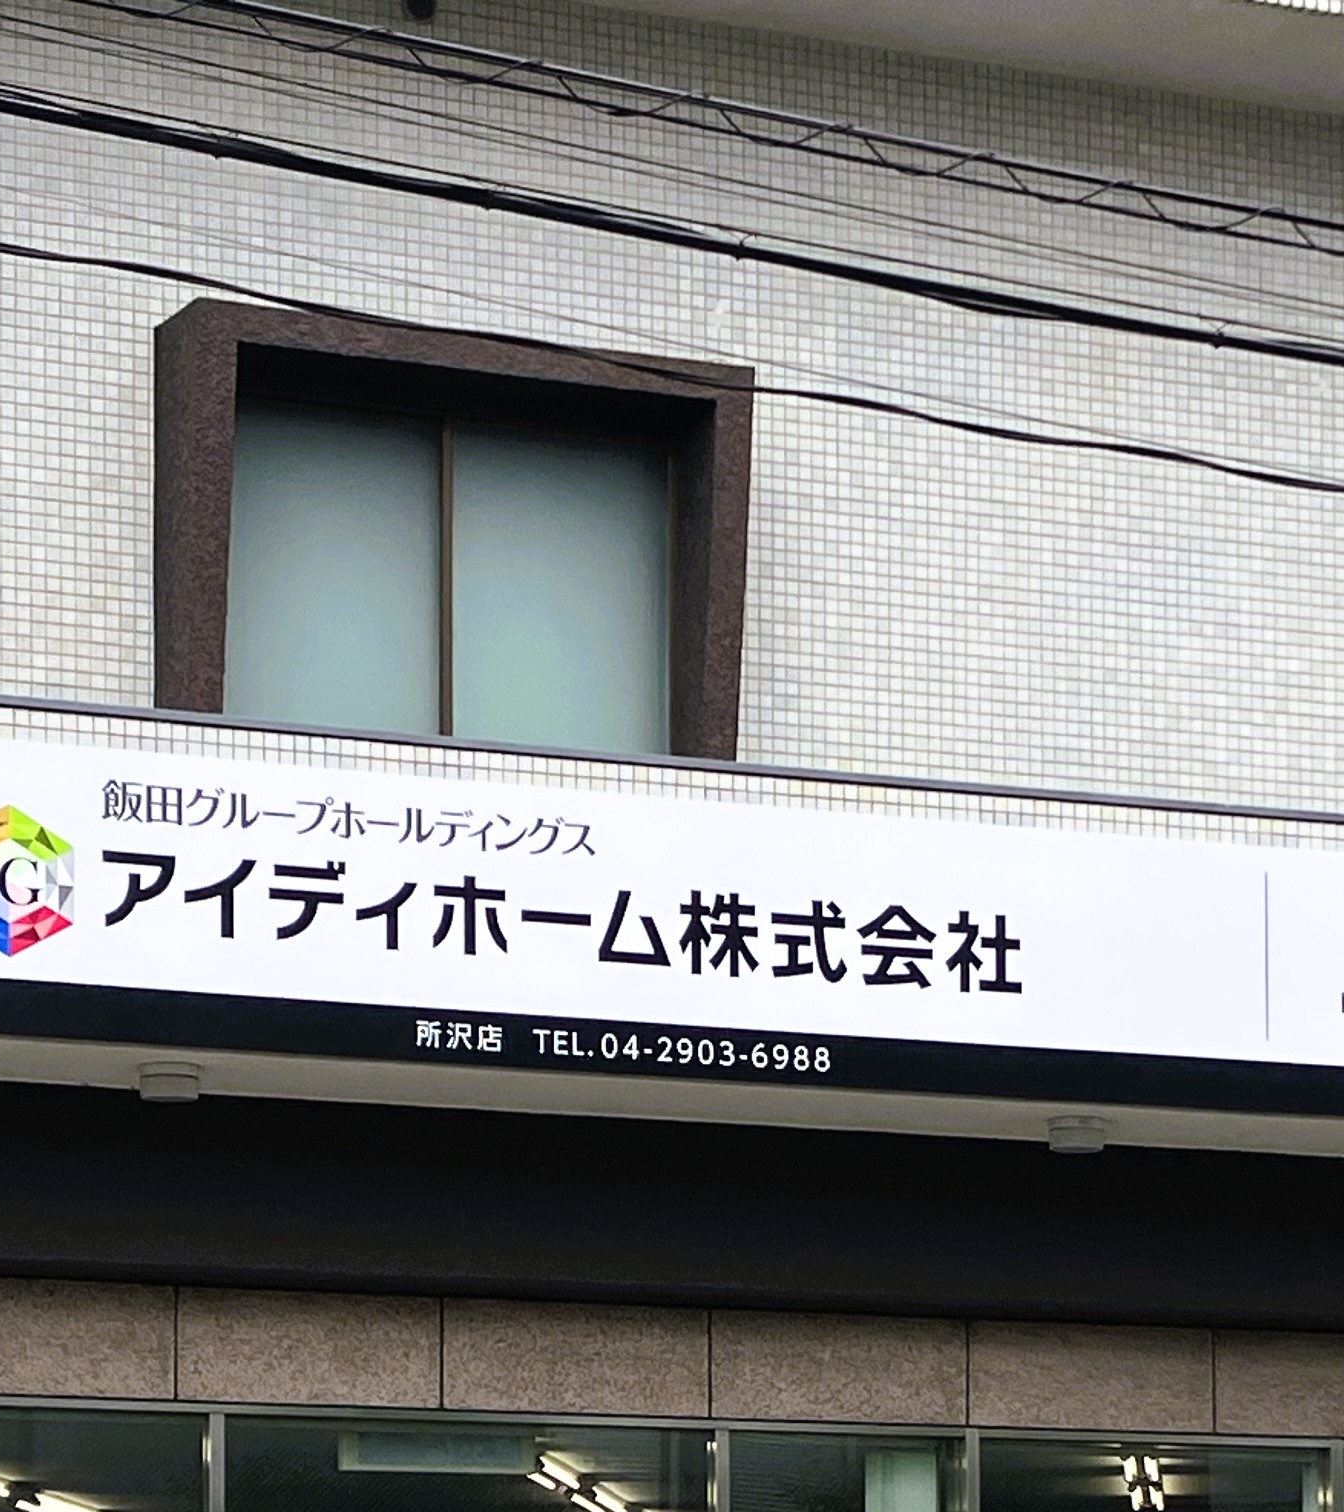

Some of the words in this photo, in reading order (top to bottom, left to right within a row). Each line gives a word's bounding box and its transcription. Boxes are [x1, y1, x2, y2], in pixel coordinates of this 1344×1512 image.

[101, 777, 597, 856] 飯田グループホールディングス
[102, 848, 1024, 995] アイディホーム株式会社
[415, 1019, 504, 1054] 所沢店
[532, 1027, 832, 1074] TEL.04-2903-6988
